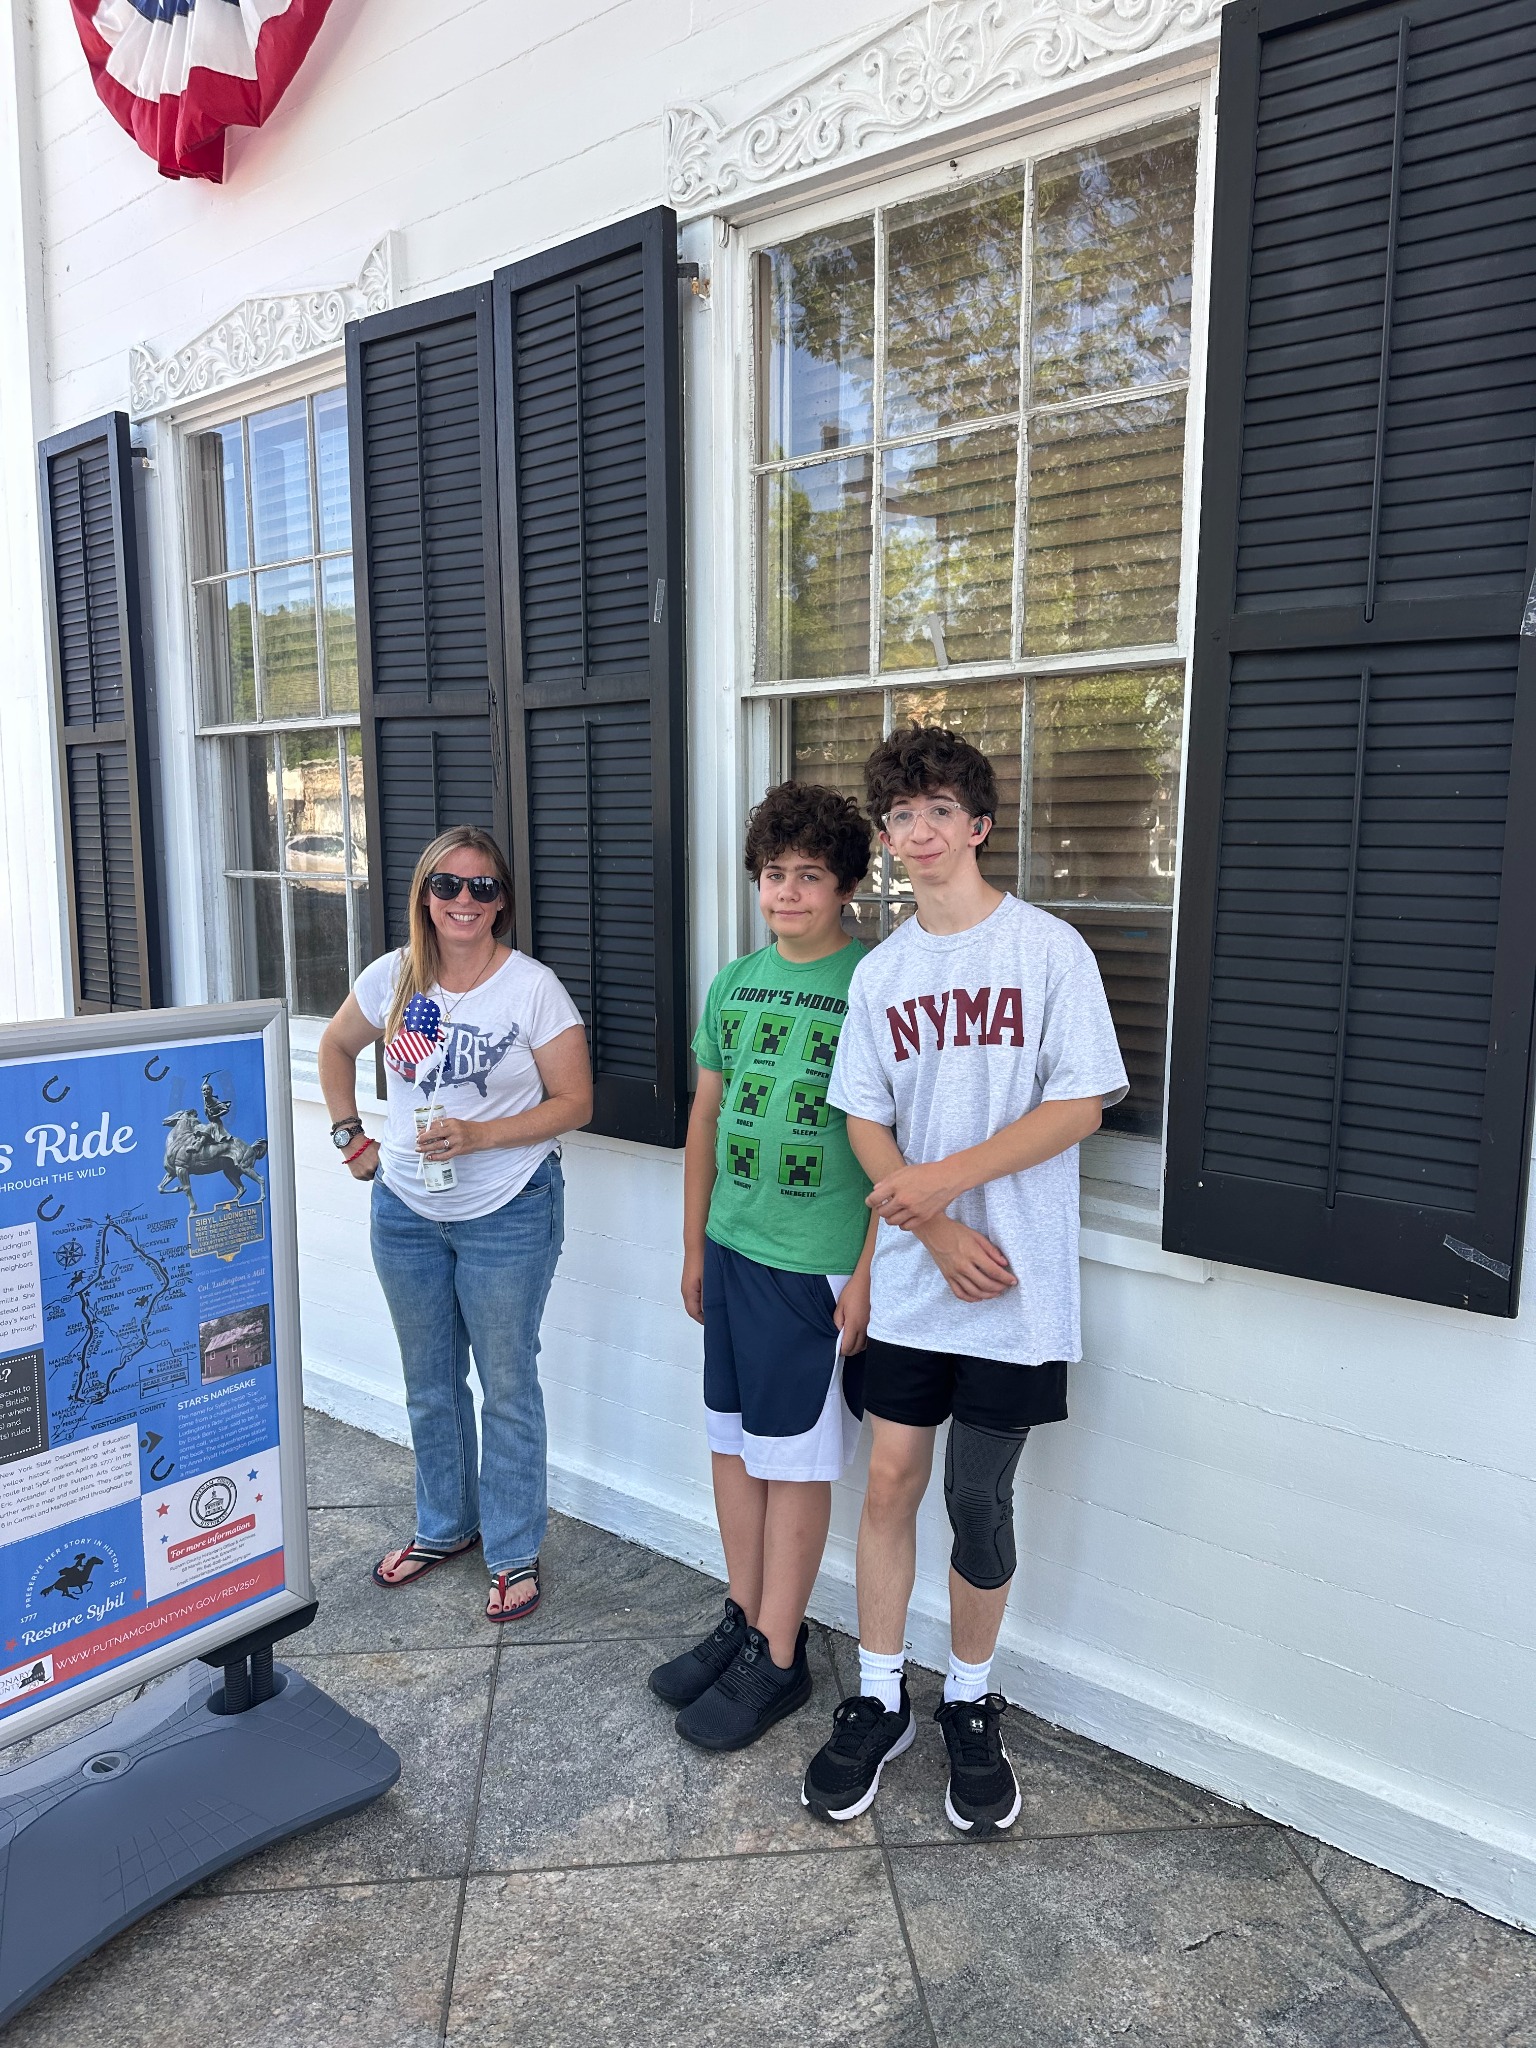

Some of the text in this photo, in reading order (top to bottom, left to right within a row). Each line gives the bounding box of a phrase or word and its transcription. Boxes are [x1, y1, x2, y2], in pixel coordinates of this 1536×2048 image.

[886, 986, 1025, 1063] NYMA
[736, 1118, 754, 1128] BORED
[24, 1111, 138, 1167] Ride
[792, 1128, 818, 1137] SLEEPY
[0, 1166, 107, 1193] HROUGH THE WILD
[780, 1188, 817, 1198] ENERGETIC
[115, 1213, 149, 1225] STORMVILLE
[195, 1208, 257, 1228] SIBYL LUDINGTON
[19, 1229, 31, 1237] that
[150, 1222, 177, 1234] COUNTY
[0, 1250, 33, 1262] enage girl
[0, 1261, 33, 1273] neighbors
[251, 1267, 266, 1279] Mill
[17, 1282, 34, 1291] likely
[97, 1283, 154, 1304] PUTNAM COUNTY
[0, 1302, 36, 1316] stead past
[0, 1318, 18, 1327] day's
[67, 1321, 83, 1331] KENT
[48, 1351, 82, 1366] MAHOPAC
[54, 1359, 74, 1369] MINES
[0, 1385, 31, 1399] acent to
[108, 1381, 140, 1396] MAHOPAC
[177, 1394, 209, 1411] STAR'S
[210, 1378, 257, 1401] NAMESAKE
[6, 1395, 29, 1408] British
[7, 1405, 32, 1417] where
[51, 1402, 86, 1418] MAHOPAC
[58, 1410, 77, 1421] FALLS
[90, 1401, 167, 1431] WESTCHESTER COUNTY
[225, 1407, 250, 1423] published
[6, 1418, 22, 1429] and
[11, 1425, 31, 1438] ruled
[187, 1435, 201, 1444] Erick
[230, 1420, 241, 1428] said
[209, 1436, 220, 1444] was
[224, 1429, 238, 1438] main
[237, 1422, 261, 1433] character
[179, 1453, 190, 1461] the
[206, 1445, 217, 1453] The
[250, 1427, 267, 1437] statue
[0, 1433, 131, 1480] New York State Department of Education
[179, 1462, 188, 1471] by
[188, 1457, 203, 1468] Anna
[203, 1453, 218, 1464] Hyatt
[247, 1434, 269, 1447] portrays
[3, 1442, 132, 1490] yellow historic markers along what was
[2, 1451, 132, 1499] route that Sybil rode on April in the
[1, 1460, 133, 1509] Eric Arctander of the Putnam Arts Council
[0, 1508, 20, 1520] urther
[21, 1503, 35, 1513] with
[41, 1496, 56, 1507] map
[56, 1491, 68, 1501] and
[68, 1487, 79, 1497] red
[97, 1477, 112, 1488] They
[113, 1473, 124, 1481] can
[6, 1478, 134, 1527] in Carmel and Mahopac and throughout the
[170, 1547, 186, 1559] For
[186, 1539, 207, 1553] more
[207, 1521, 252, 1545] information
[25, 1538, 121, 1610] PRESERVE HER STORY IN HISTORY
[109, 1576, 127, 1588] 2027
[20, 1612, 38, 1624] 1777
[21, 1591, 126, 1646] Restore Sybil
[56, 1573, 261, 1671] WWW.PUTNAMCOUNTYNY.GOV/REV250/
